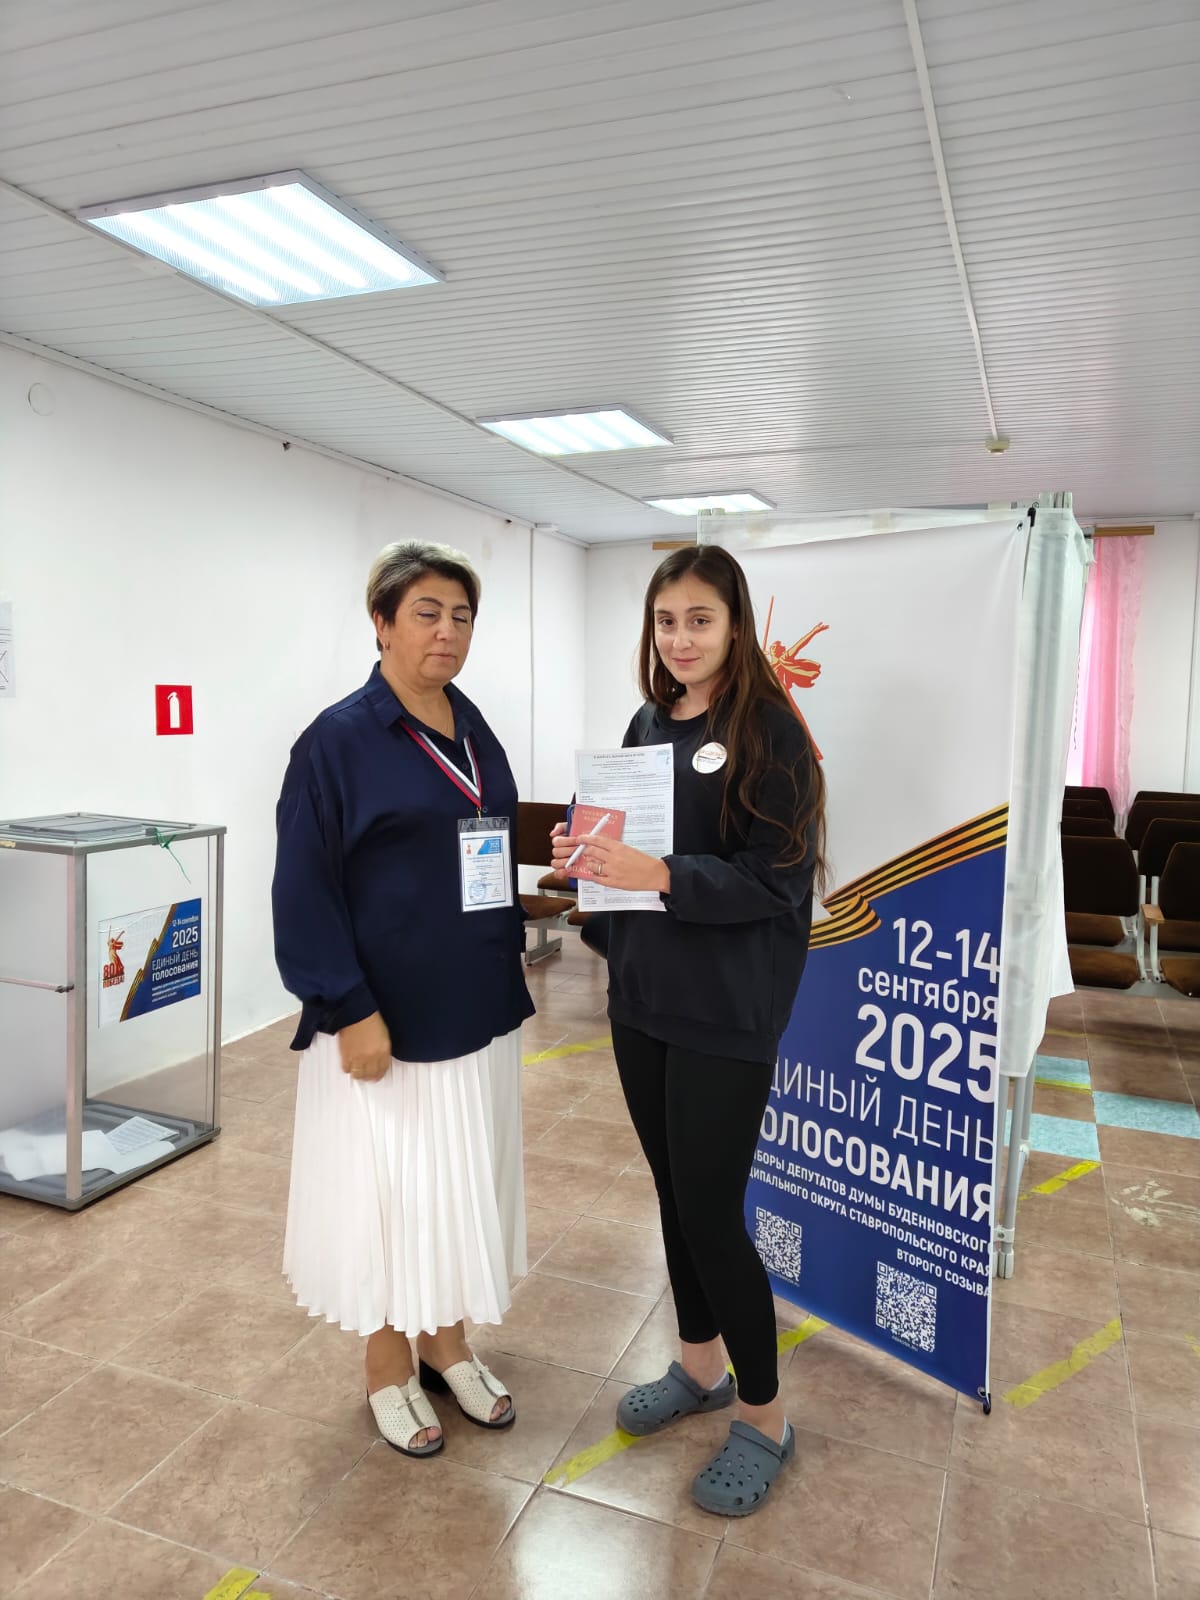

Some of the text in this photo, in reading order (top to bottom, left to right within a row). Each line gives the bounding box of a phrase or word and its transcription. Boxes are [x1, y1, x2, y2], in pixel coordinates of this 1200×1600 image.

[152, 949, 199, 971] ЕДИНЫЙ ДЕНЬ
[172, 926, 198, 948] 2025
[893, 917, 1000, 983] 12-14
[858, 967, 999, 1025] сентября
[855, 1003, 997, 1103] 2025
[893, 1095, 994, 1164] ДЕНЬ
[753, 1149, 785, 1171] БОРЫ
[787, 1162, 847, 1196] ДЕПУТАТОВ
[849, 1187, 885, 1212] ДУМЫ
[760, 1105, 992, 1227] ОЛОСОВАНИЯ
[749, 1166, 808, 1200] ЦИПАЛЬНОГО
[811, 1192, 847, 1217] ОКРУГА
[849, 1208, 957, 1264] СТАВРОПОЛЬСКОГО
[897, 1248, 942, 1278] ВТОРОГО
